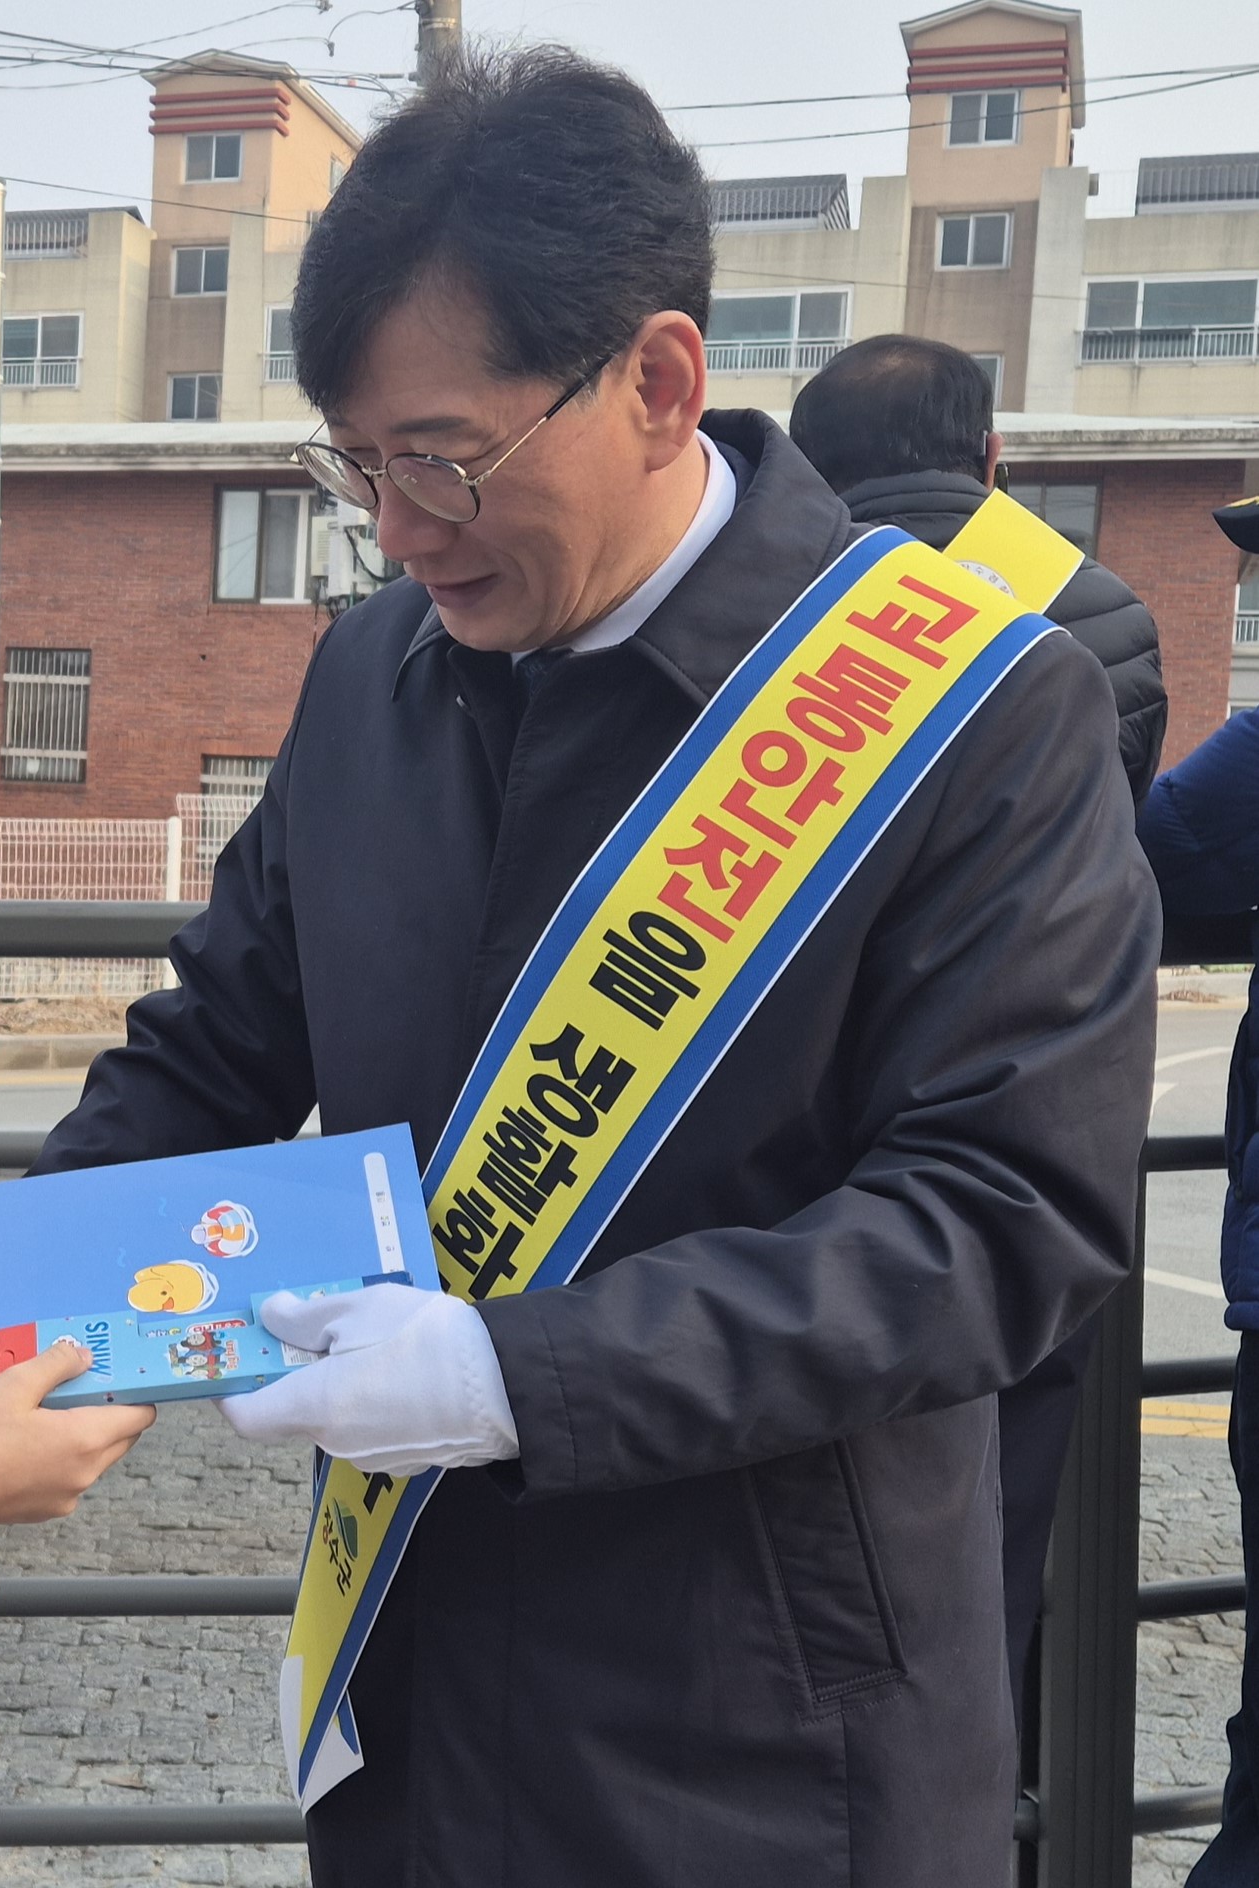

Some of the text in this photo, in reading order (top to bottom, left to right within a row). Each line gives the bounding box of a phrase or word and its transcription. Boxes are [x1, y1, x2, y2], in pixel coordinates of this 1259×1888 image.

[430, 574, 980, 1301] 교통안전을 생활화
[85, 1321, 112, 1376] MINIS
[322, 1503, 353, 1598] 장수군
